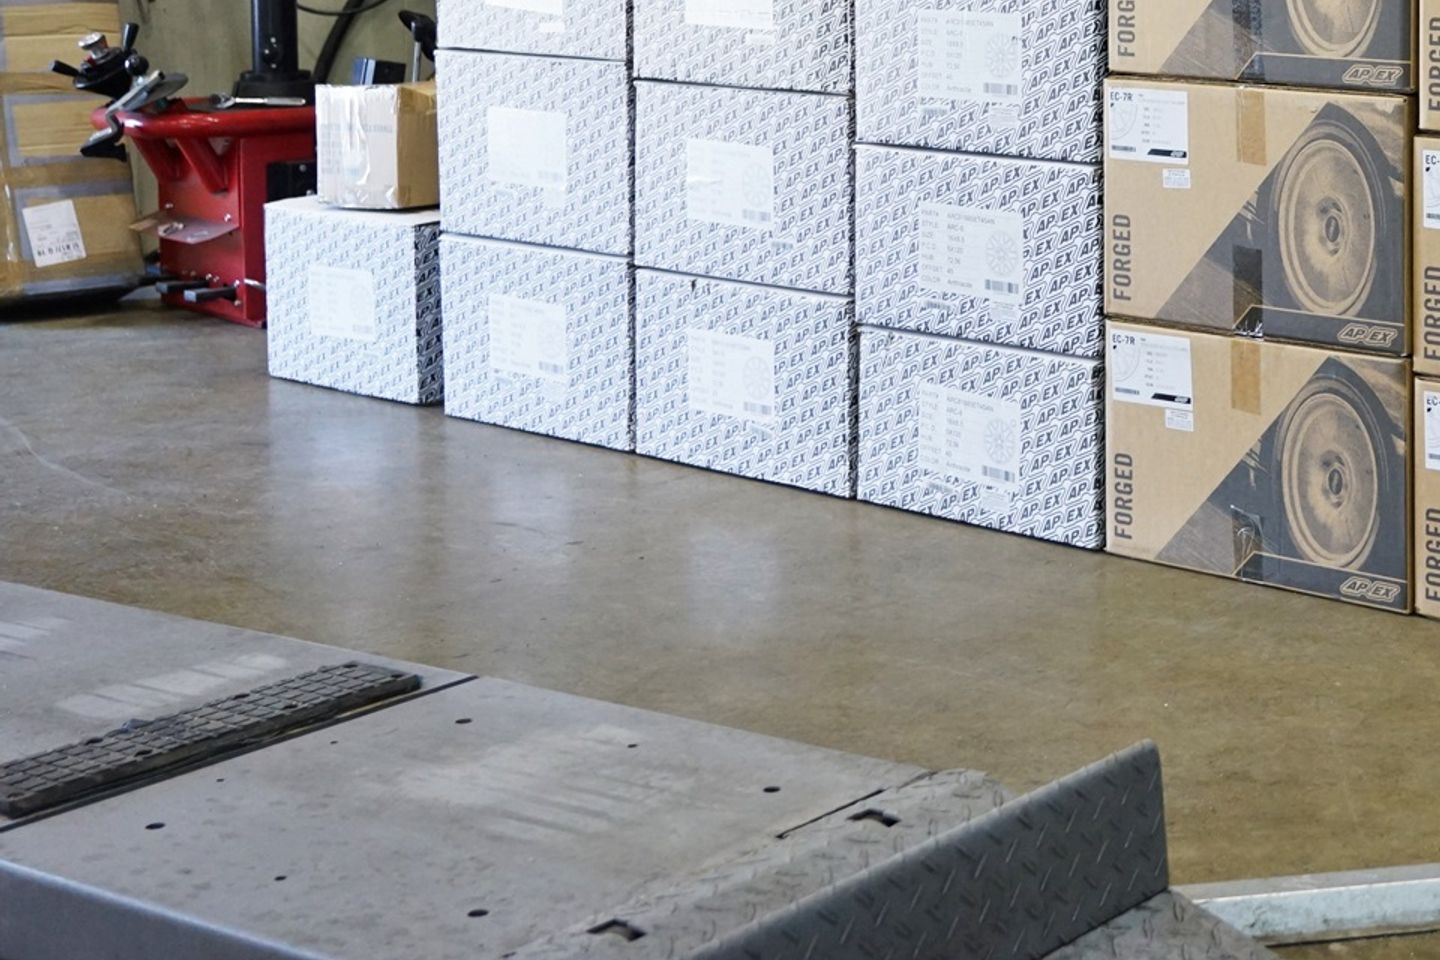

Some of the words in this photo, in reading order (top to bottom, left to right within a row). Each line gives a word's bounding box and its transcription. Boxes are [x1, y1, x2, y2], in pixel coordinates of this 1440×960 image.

[1110, 92, 1133, 102] EC-7R
[1113, 213, 1132, 302] FORGED
[1114, 452, 1133, 540] FORGED
